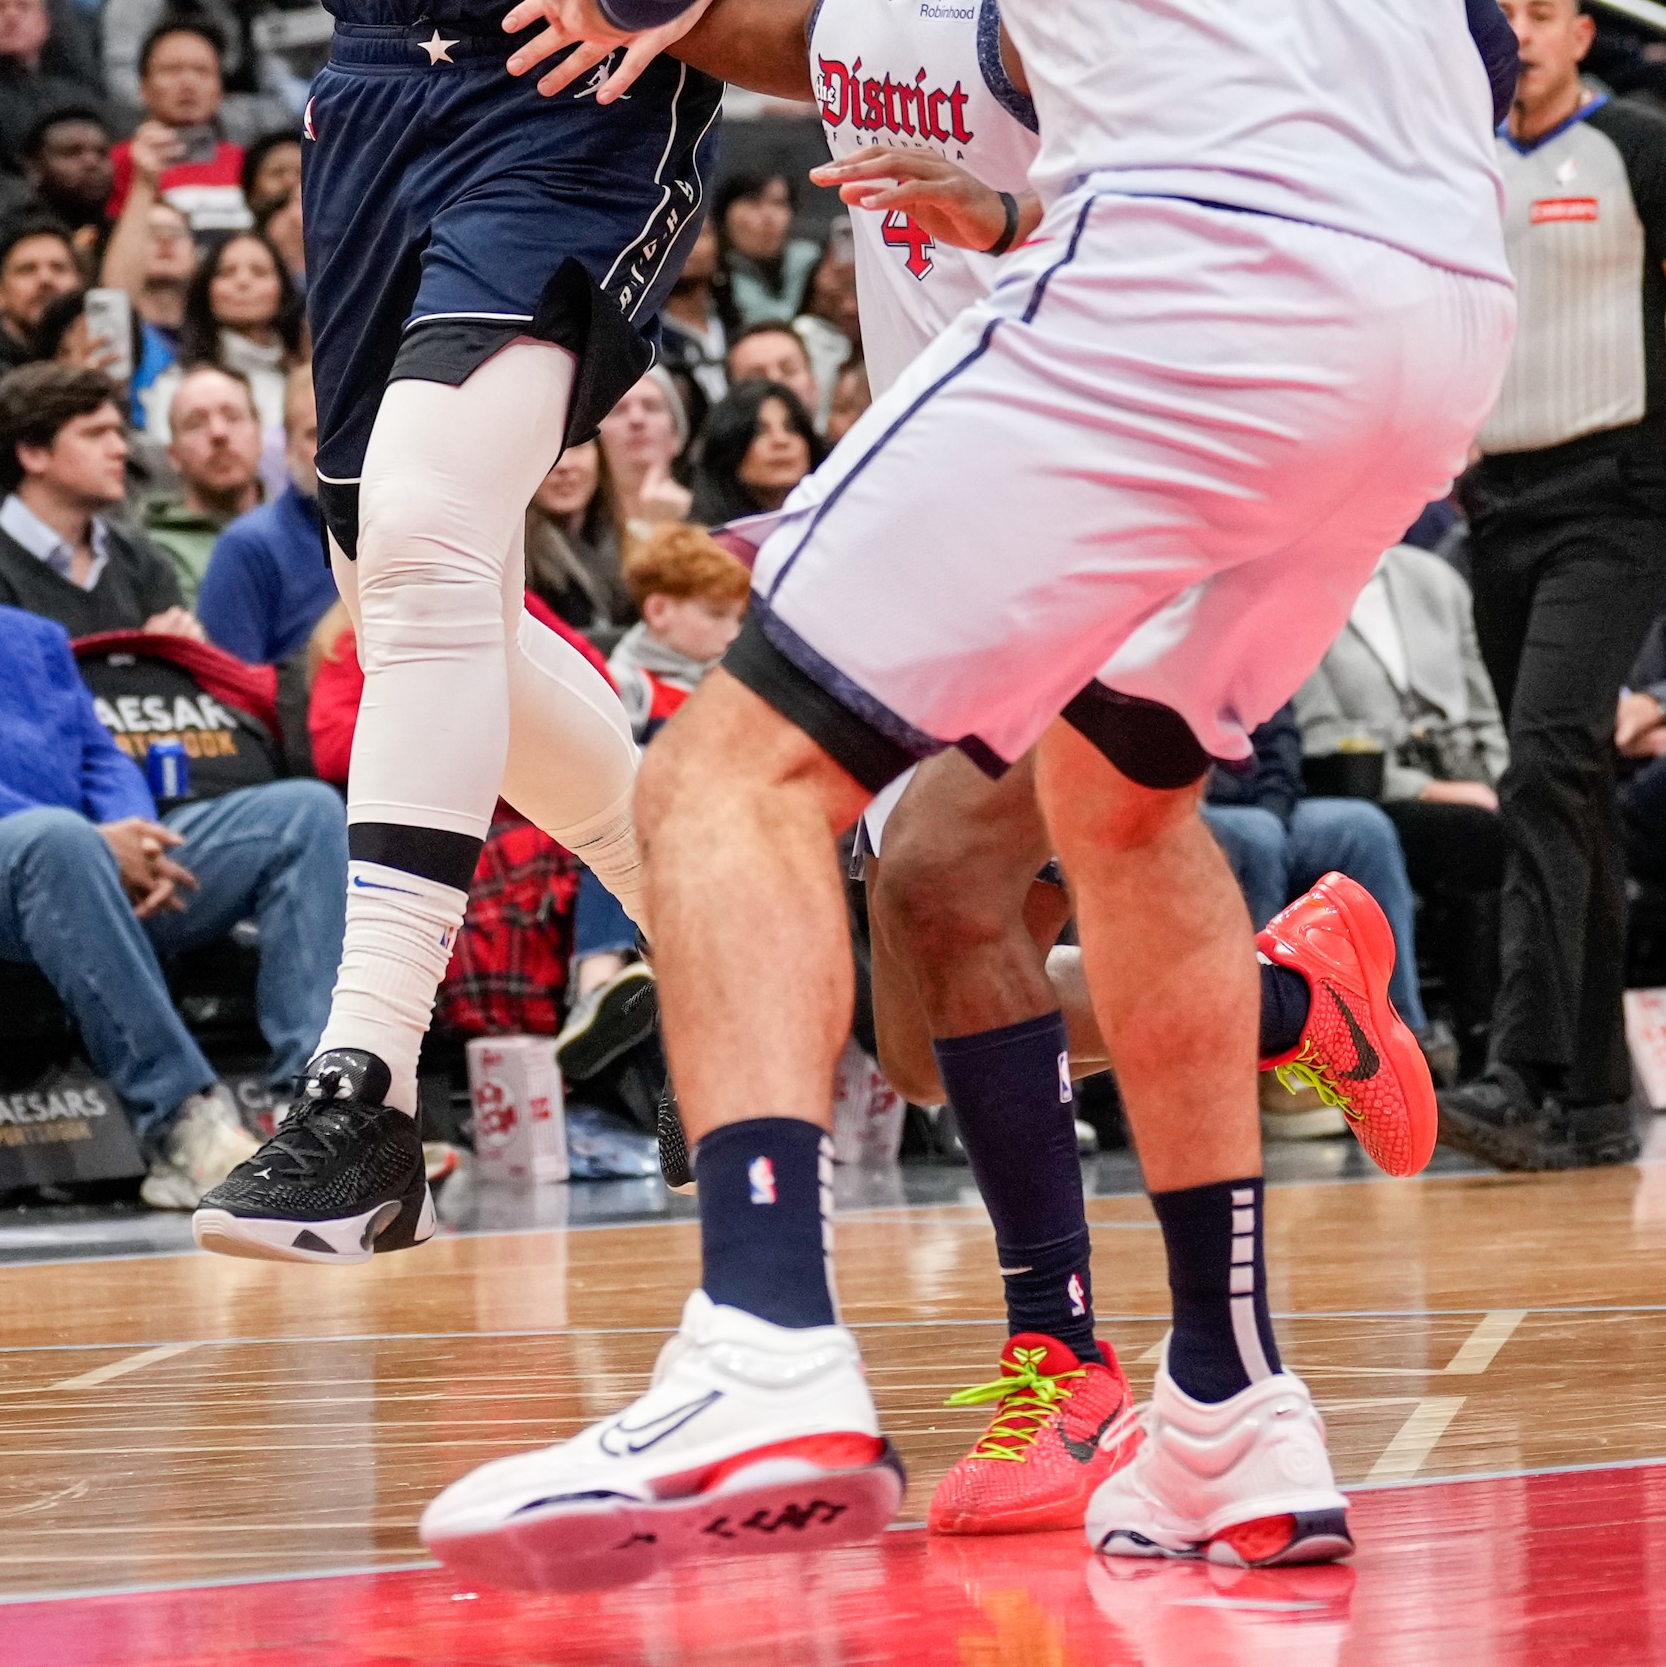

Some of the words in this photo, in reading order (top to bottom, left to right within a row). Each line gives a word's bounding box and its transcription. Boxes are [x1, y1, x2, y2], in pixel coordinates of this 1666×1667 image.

[919, 3, 976, 21] Robinhood
[819, 52, 975, 145] District
[881, 179, 935, 281] 4
